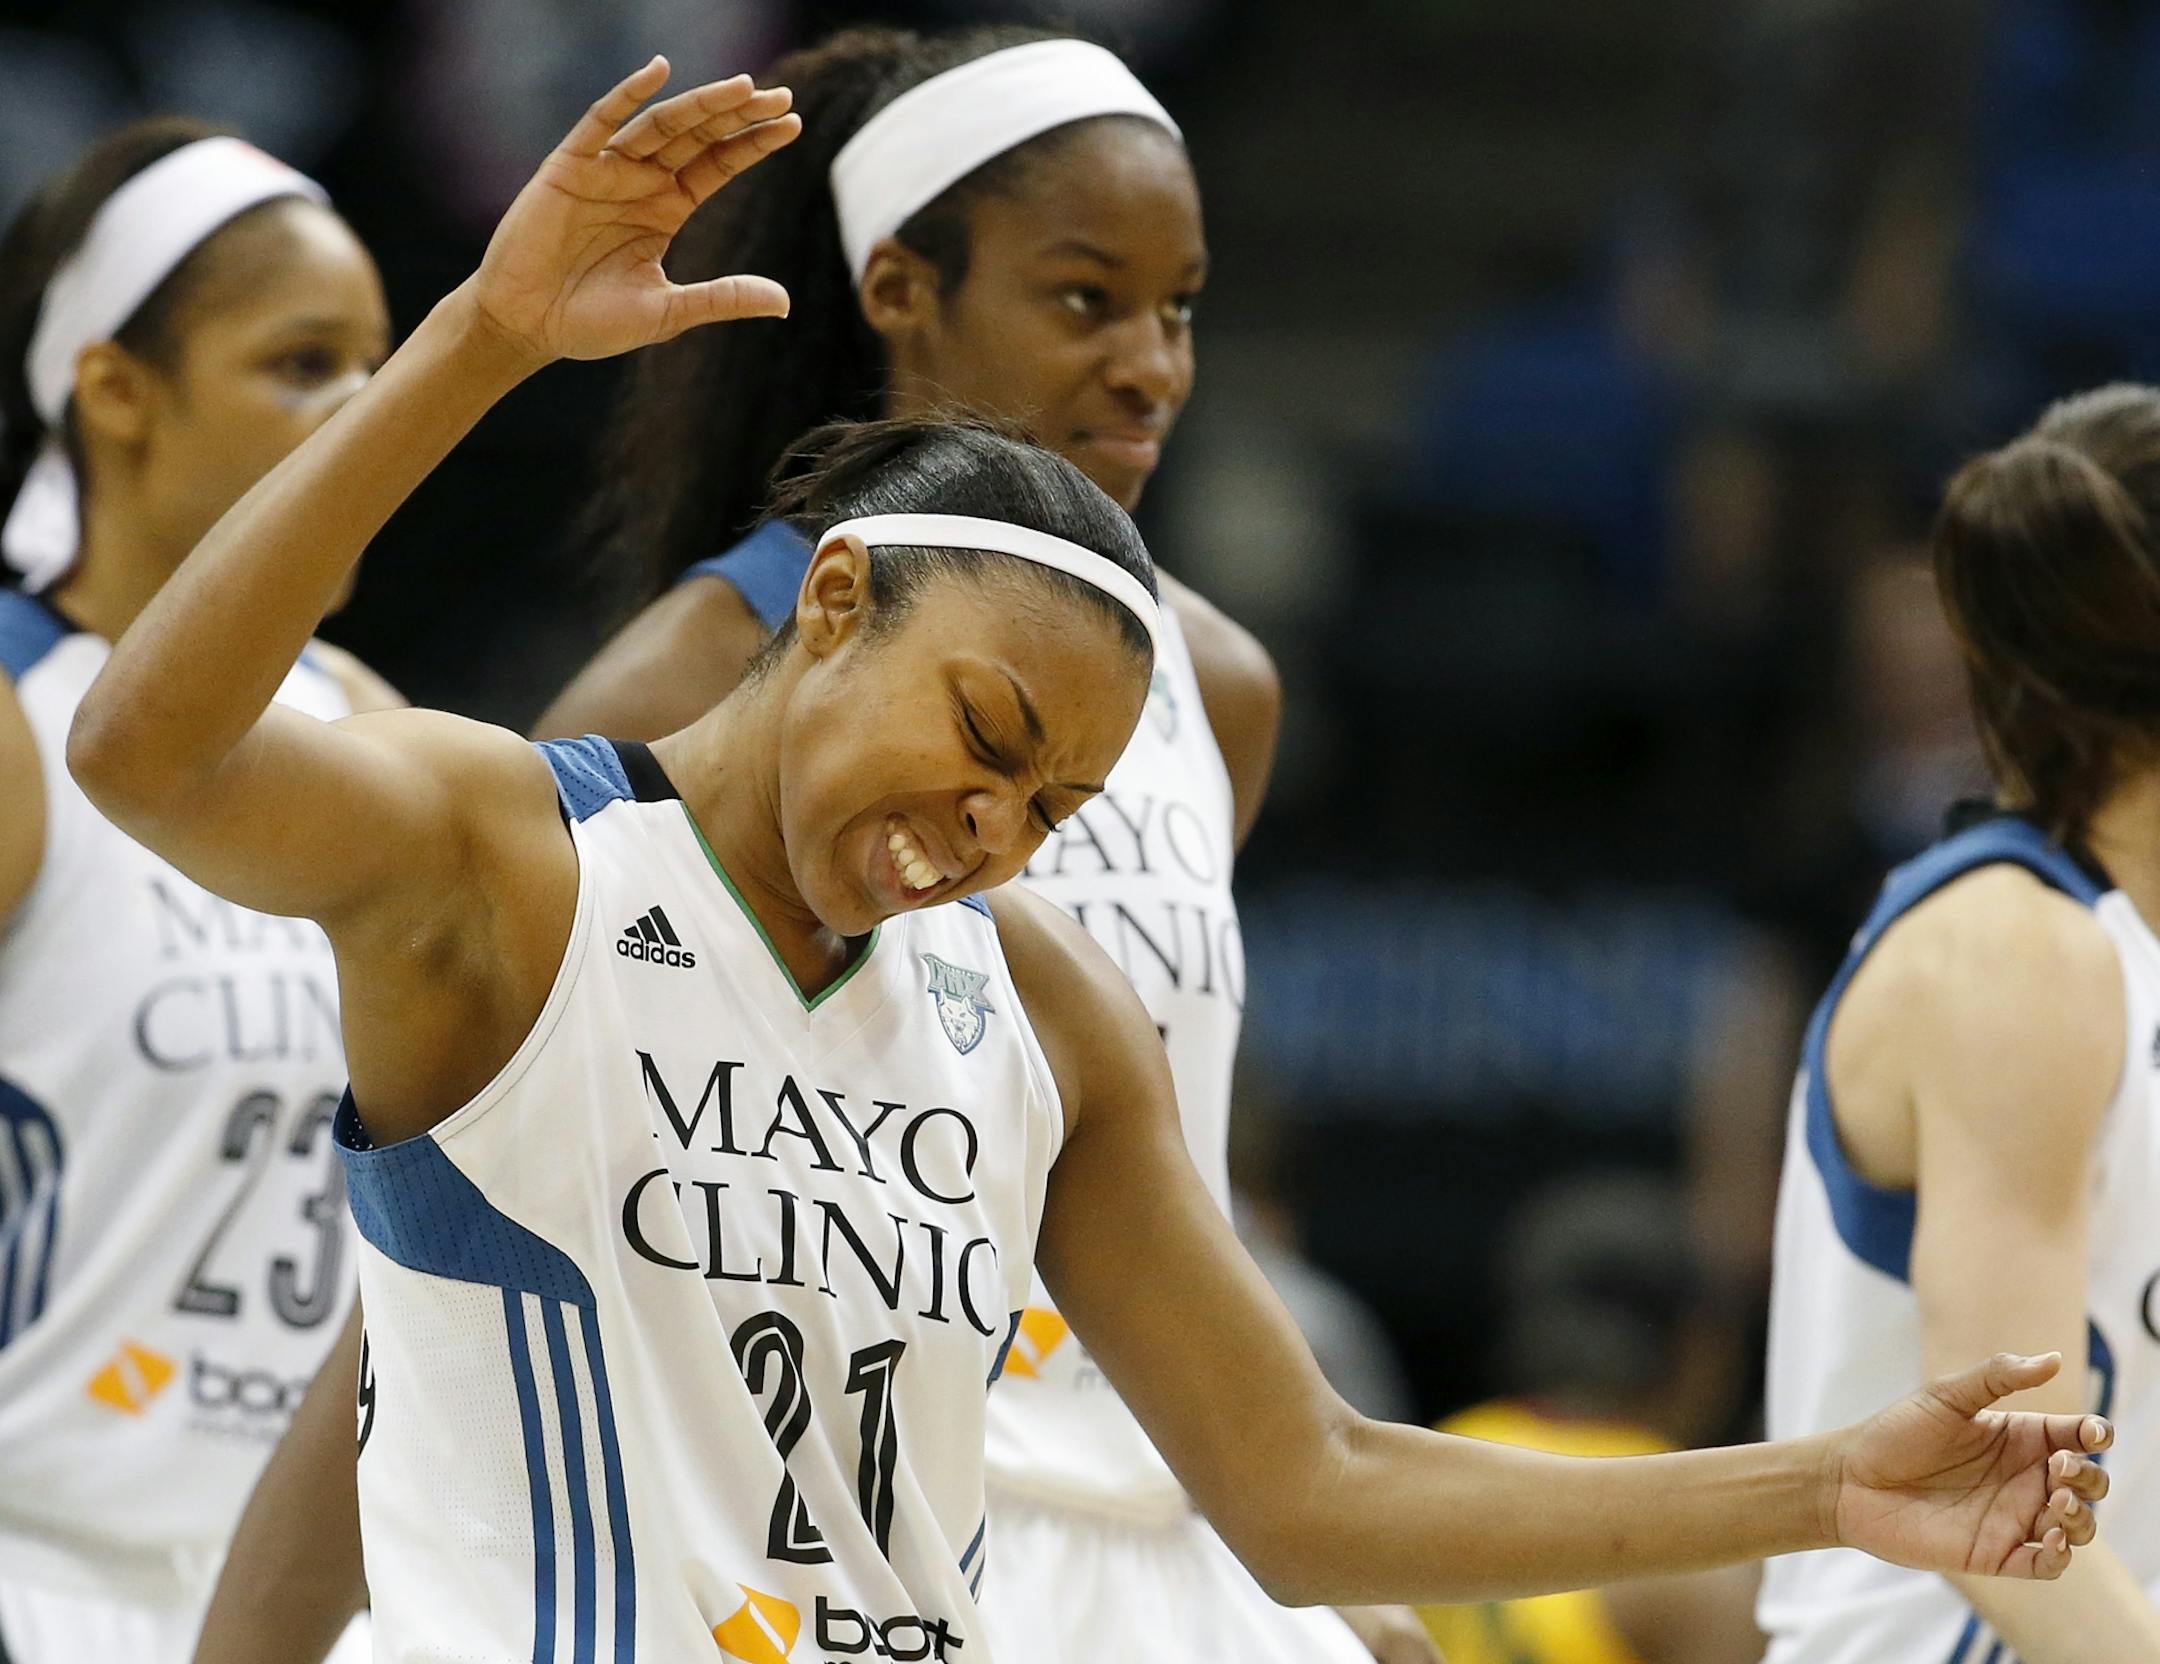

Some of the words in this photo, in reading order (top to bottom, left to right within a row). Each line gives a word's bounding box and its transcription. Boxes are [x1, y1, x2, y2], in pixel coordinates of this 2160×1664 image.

[1023, 791, 1217, 885] AYO
[616, 935, 697, 969] adidas
[172, 1086, 346, 1329] 23
[635, 1049, 978, 1205] MAYO
[622, 1168, 998, 1337] CLINIC
[730, 1311, 908, 1565] 21
